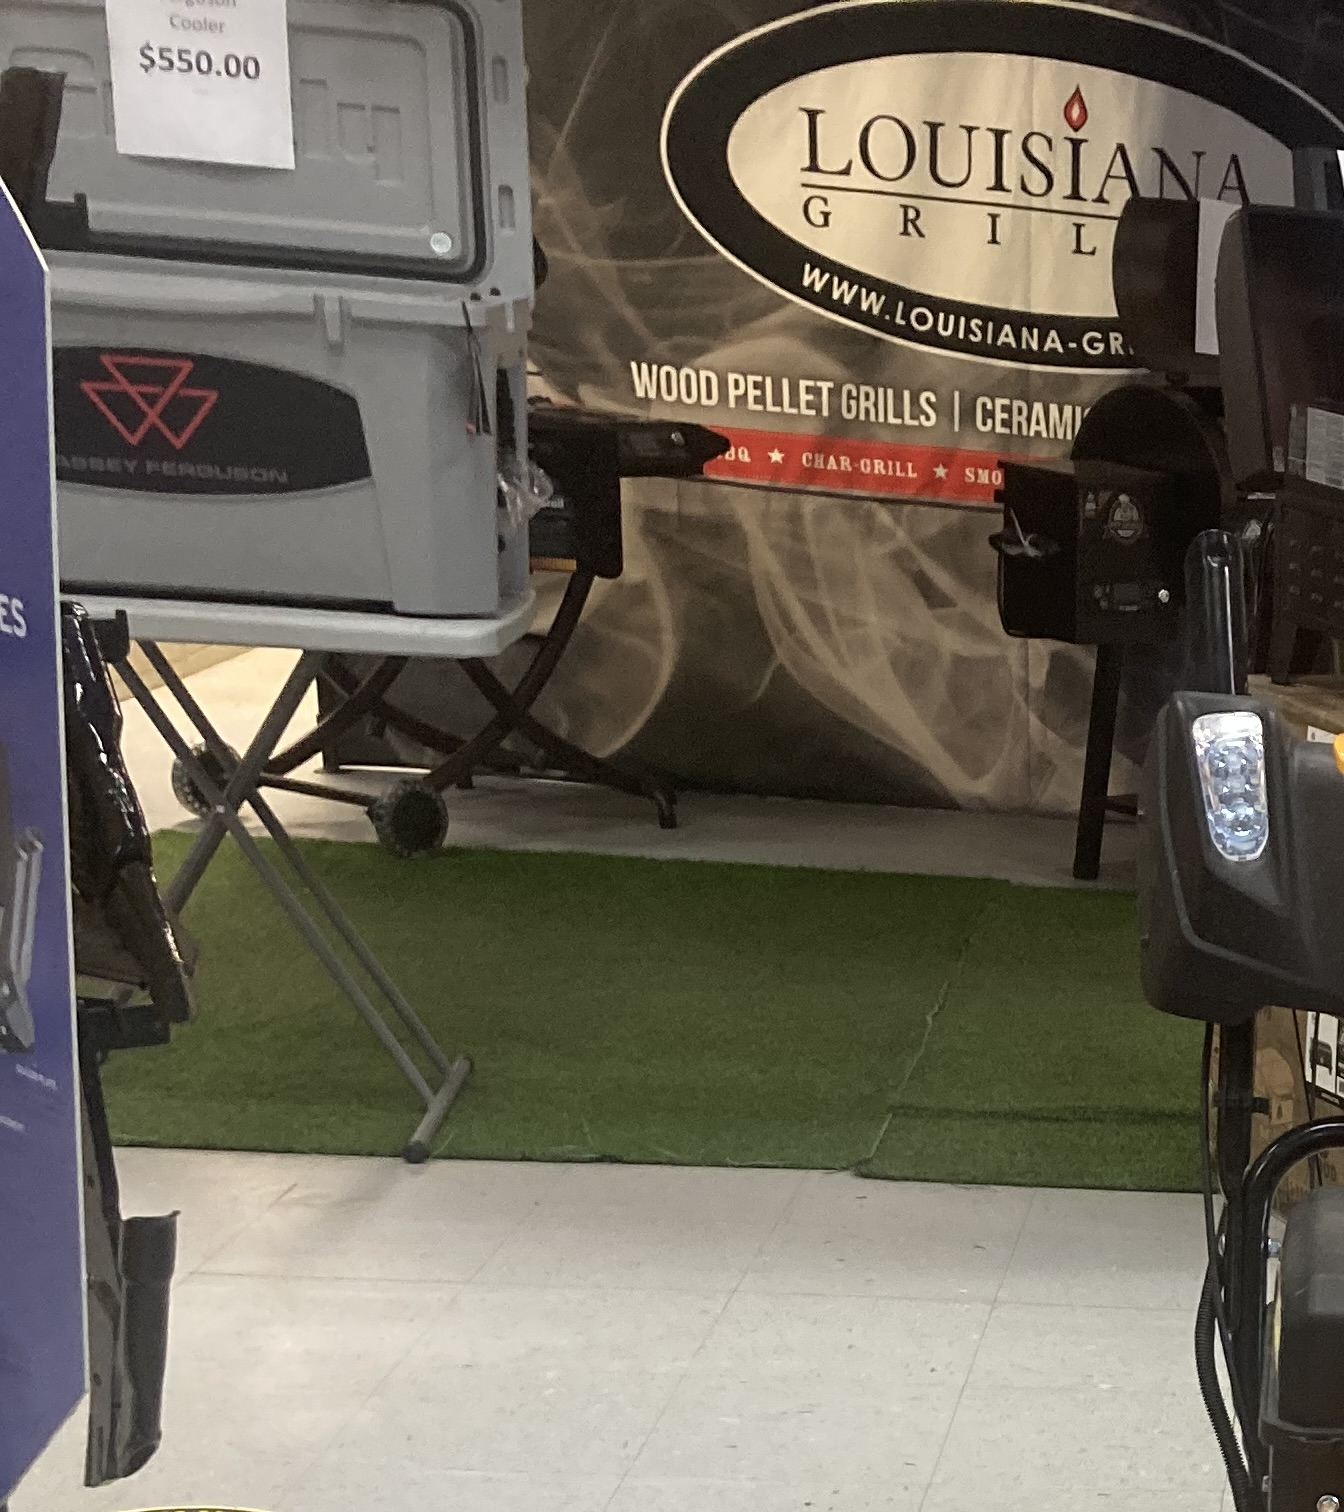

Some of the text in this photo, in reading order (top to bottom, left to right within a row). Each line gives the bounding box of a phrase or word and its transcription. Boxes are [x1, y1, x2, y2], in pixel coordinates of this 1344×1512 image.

[169, 13, 226, 33] Cooler
[139, 40, 261, 80] $550.00
[799, 106, 1252, 205] LOUISIANA
[803, 195, 1098, 256] GRIL
[630, 361, 719, 406] WOOD
[727, 372, 834, 417] PELLET
[841, 383, 937, 428] GRILLS
[717, 445, 752, 464] BQ
[801, 452, 918, 479] CHAR-GRILL
[964, 467, 1001, 486] SMO
